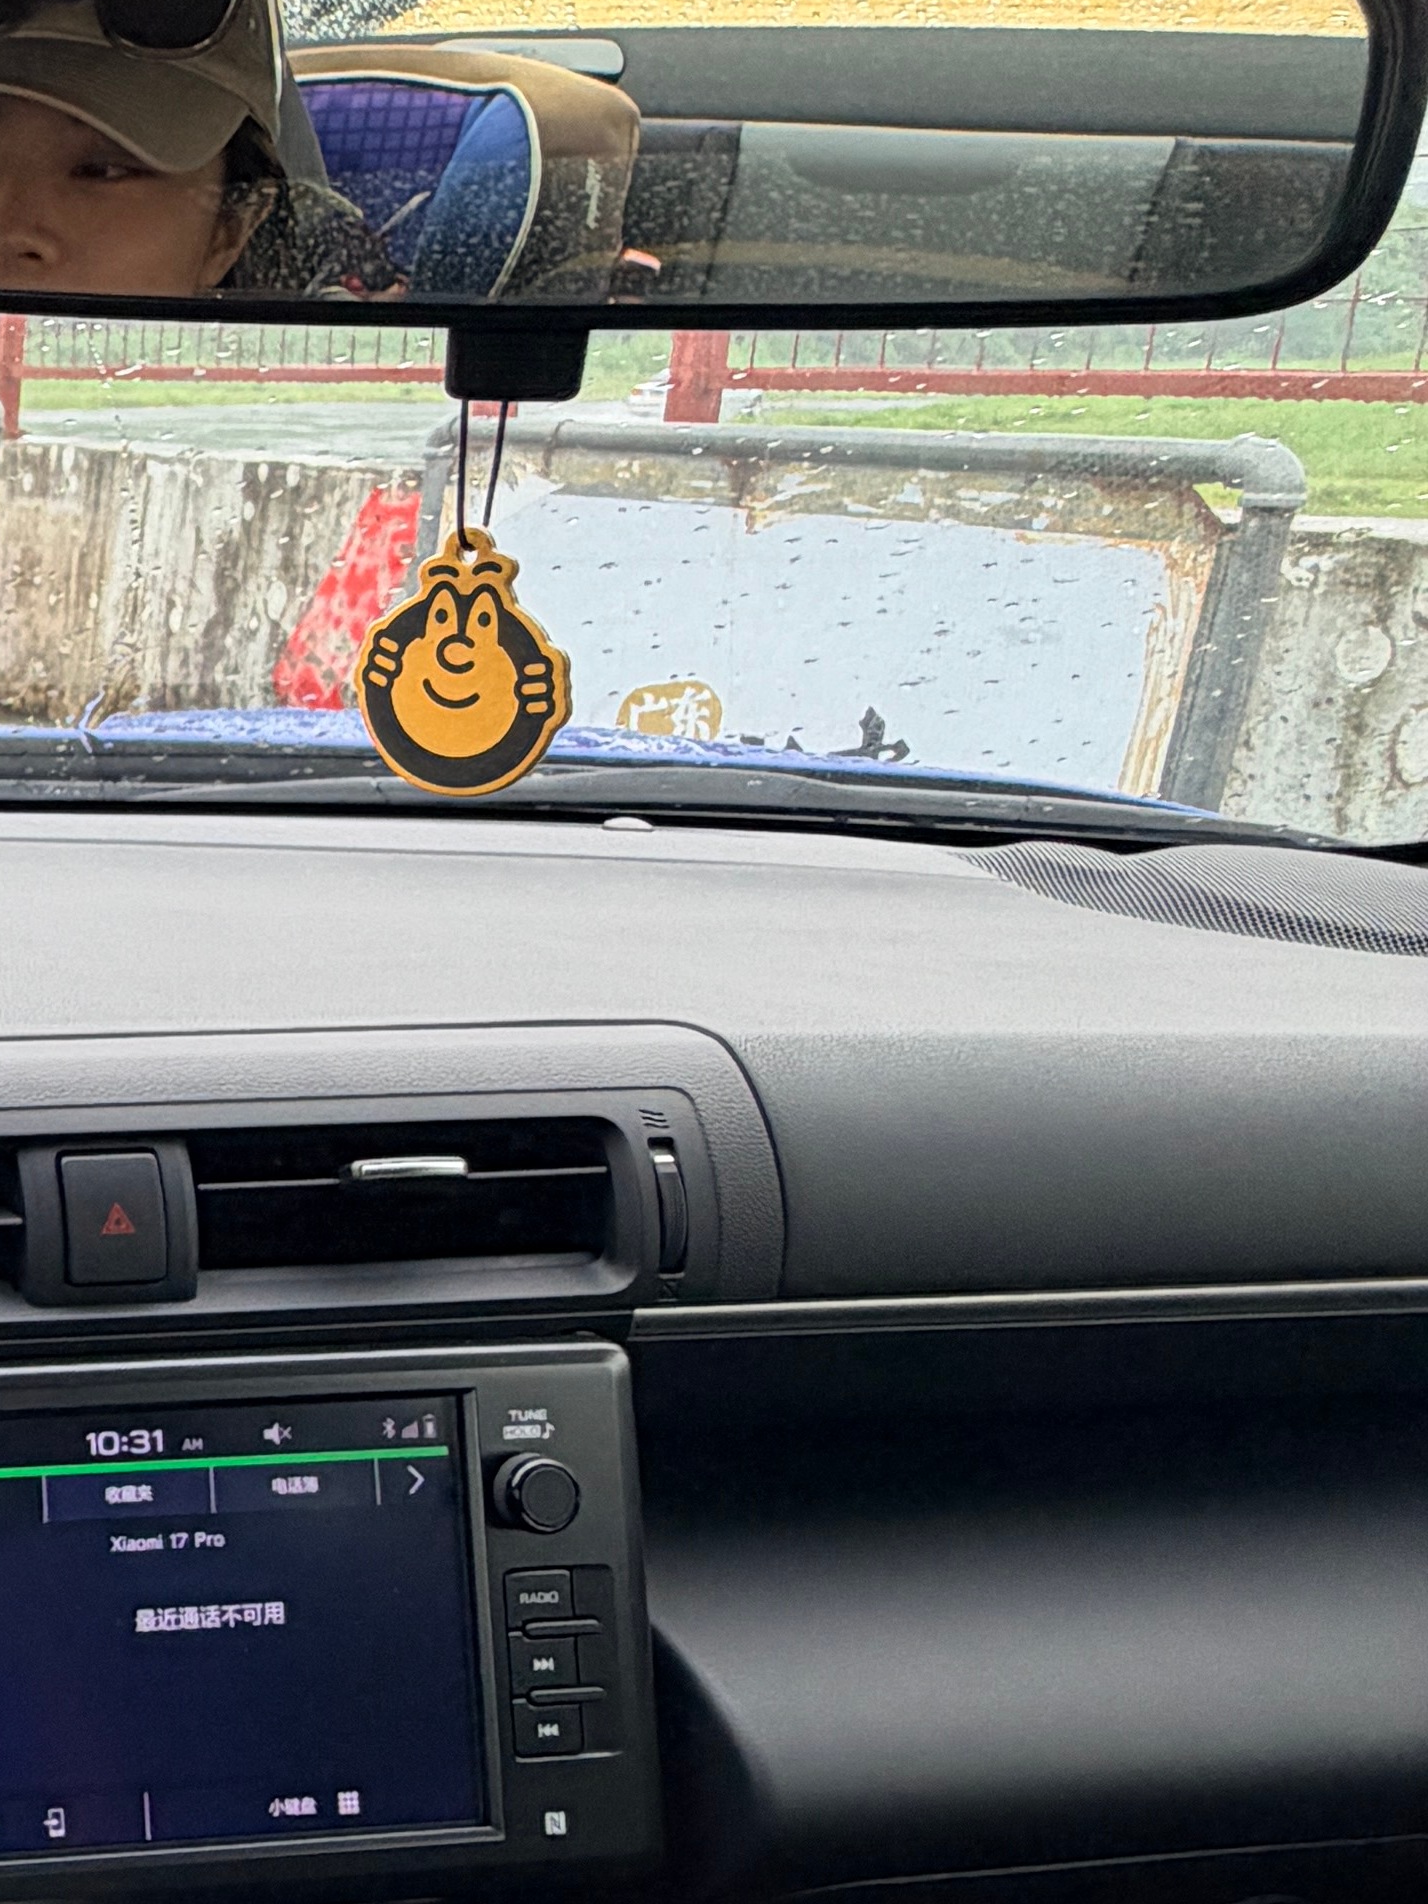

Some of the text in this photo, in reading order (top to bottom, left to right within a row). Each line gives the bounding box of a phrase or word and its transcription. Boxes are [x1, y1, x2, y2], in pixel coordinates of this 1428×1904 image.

[508, 1408, 547, 1422] TUNE
[85, 1429, 204, 1456] 10:31 AM
[110, 1531, 226, 1553] Xiaomi 17 Pro
[519, 1590, 559, 1604] RADIO
[135, 1600, 286, 1633] 最近通话不可用
